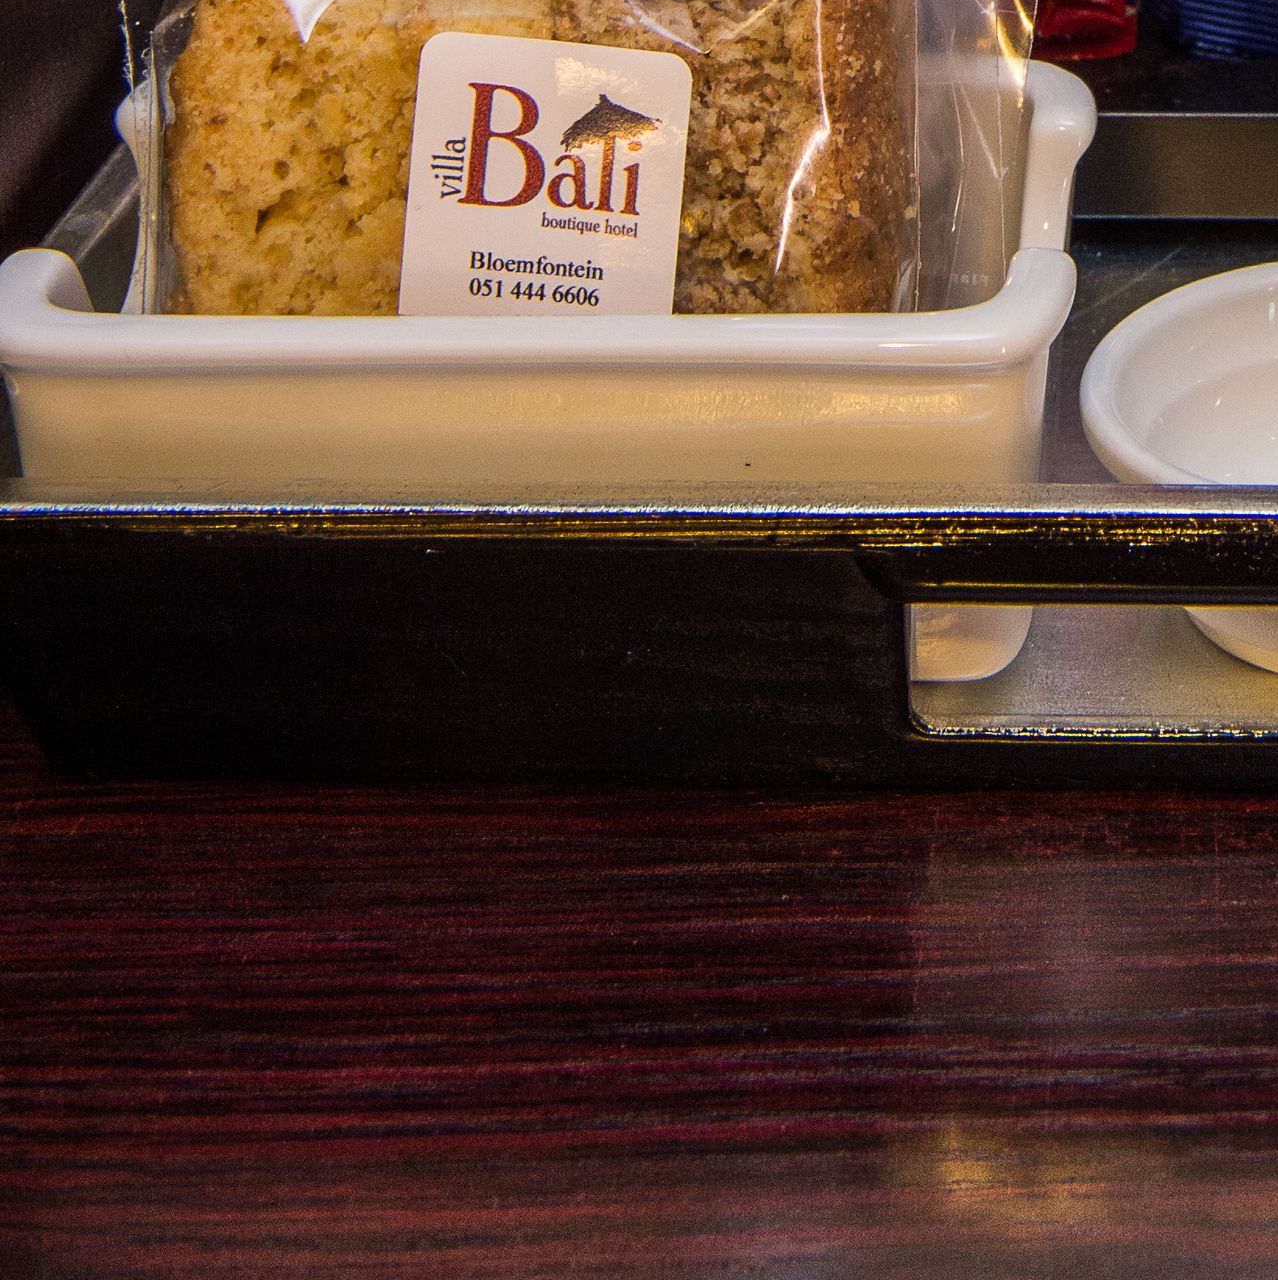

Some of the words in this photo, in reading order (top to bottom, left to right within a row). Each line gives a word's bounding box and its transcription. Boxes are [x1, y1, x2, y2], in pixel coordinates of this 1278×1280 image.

[458, 81, 643, 215] Bali
[431, 137, 467, 199] villa
[541, 212, 601, 234] boutique
[604, 218, 639, 239] hotel
[470, 250, 605, 281] Bloemfontein
[469, 277, 503, 298] 051
[510, 282, 546, 301] 444
[551, 284, 600, 307] 6606
